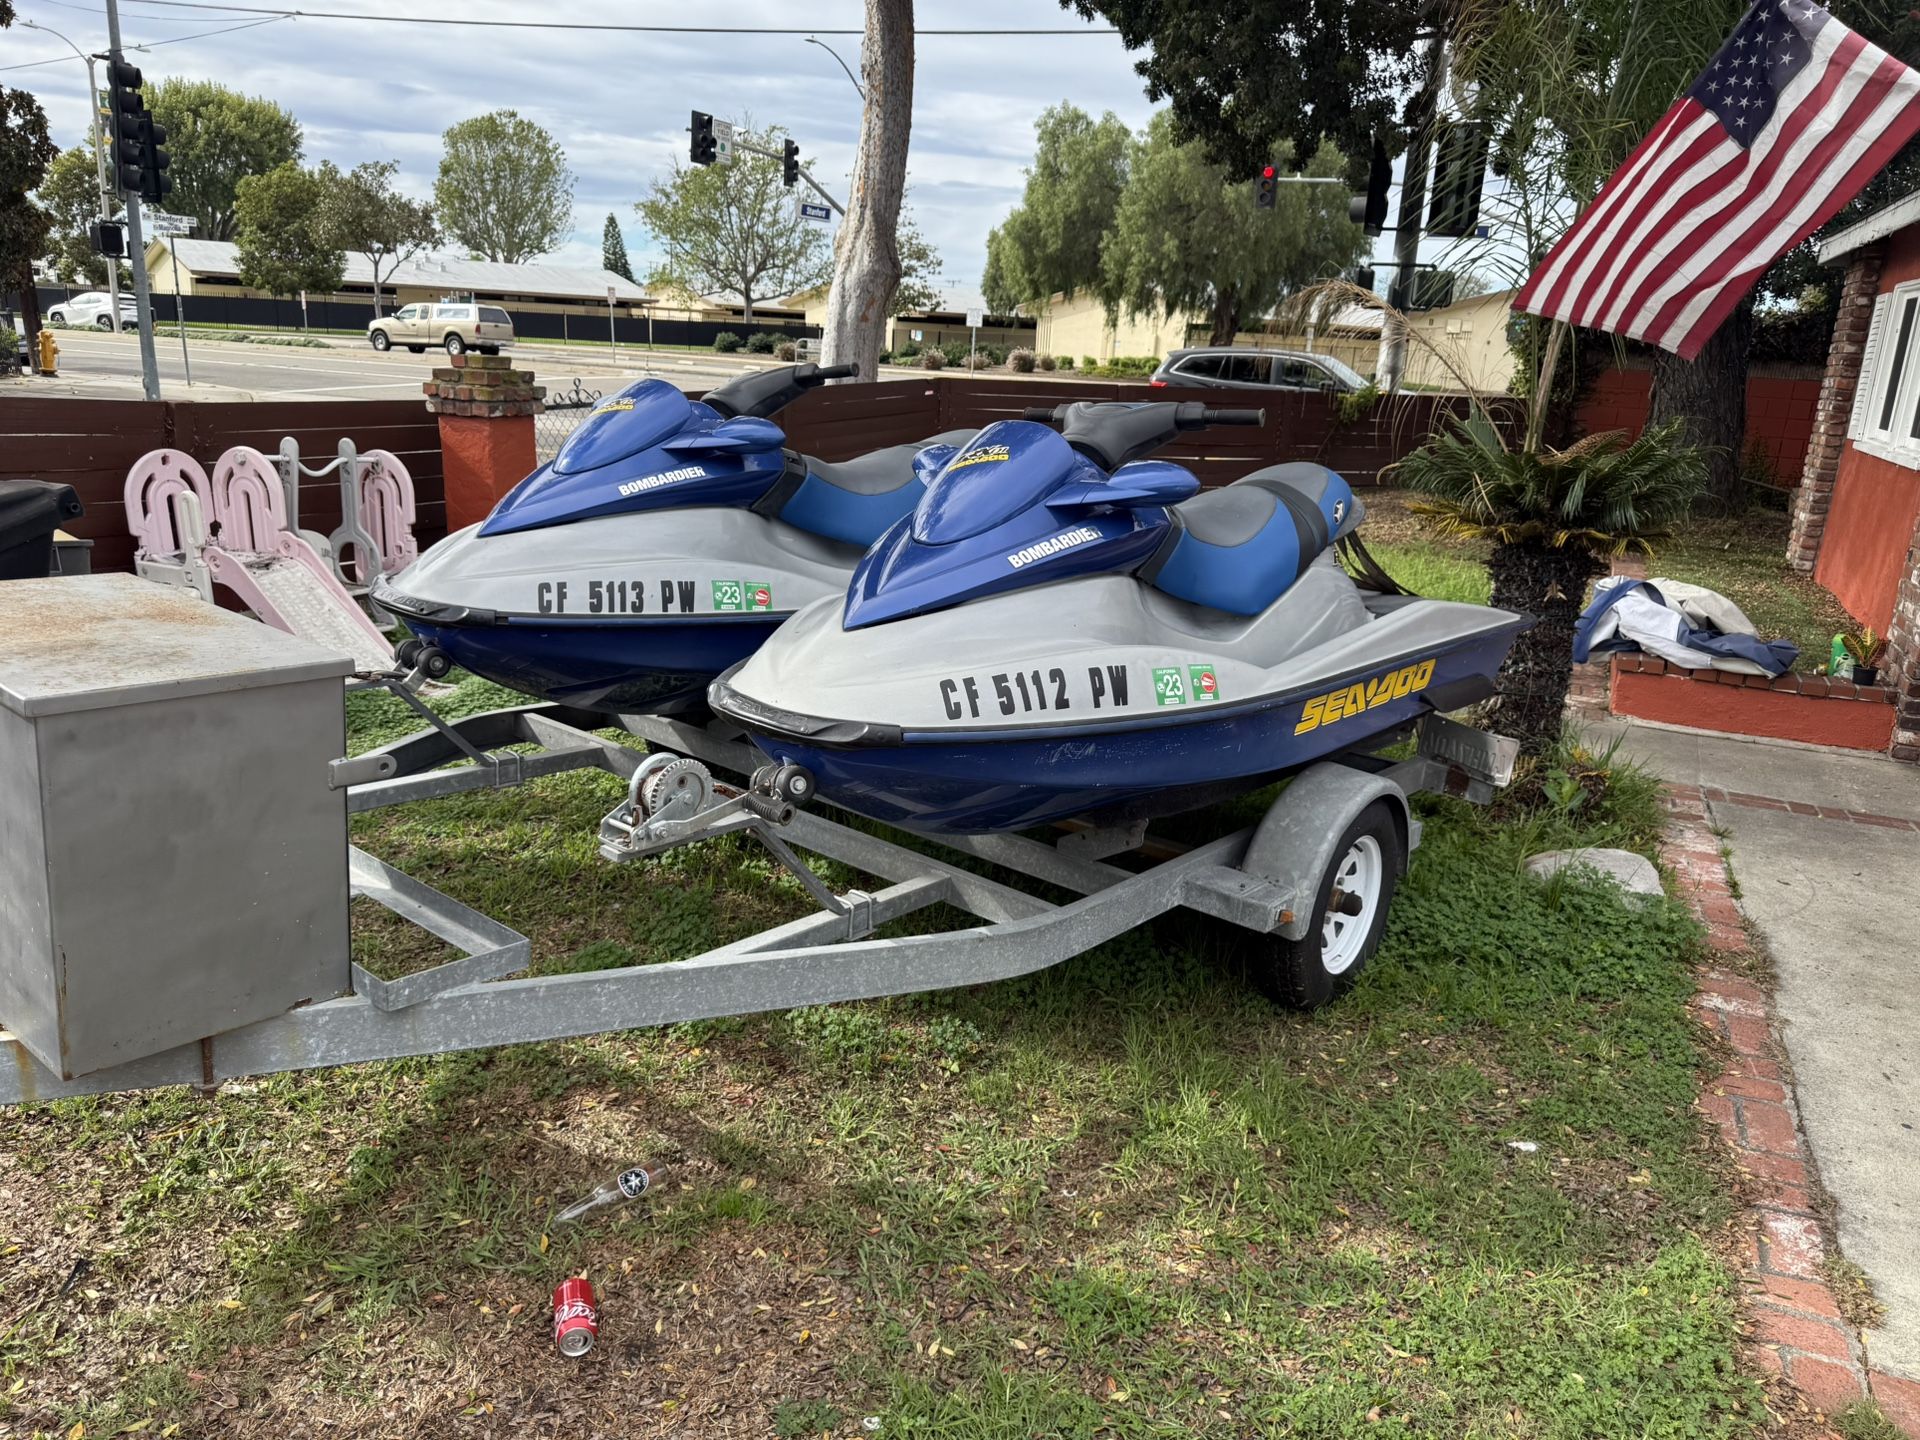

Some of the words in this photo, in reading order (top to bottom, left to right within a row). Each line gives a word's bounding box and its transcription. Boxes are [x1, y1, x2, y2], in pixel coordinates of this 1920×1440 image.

[717, 128, 730, 137] YIELD
[153, 213, 183, 223] Stanford
[806, 206, 826, 218] Stanford
[617, 466, 706, 496] BOMBARDIER
[1007, 526, 1103, 568] BOMBARDIER
[538, 581, 567, 613] CF
[588, 580, 644, 613] 5113
[660, 580, 695, 613] PW
[722, 586, 741, 603] 23
[939, 676, 980, 721] CF
[992, 668, 1070, 716] 5112
[1088, 665, 1129, 709] PW
[1163, 674, 1183, 696] 23
